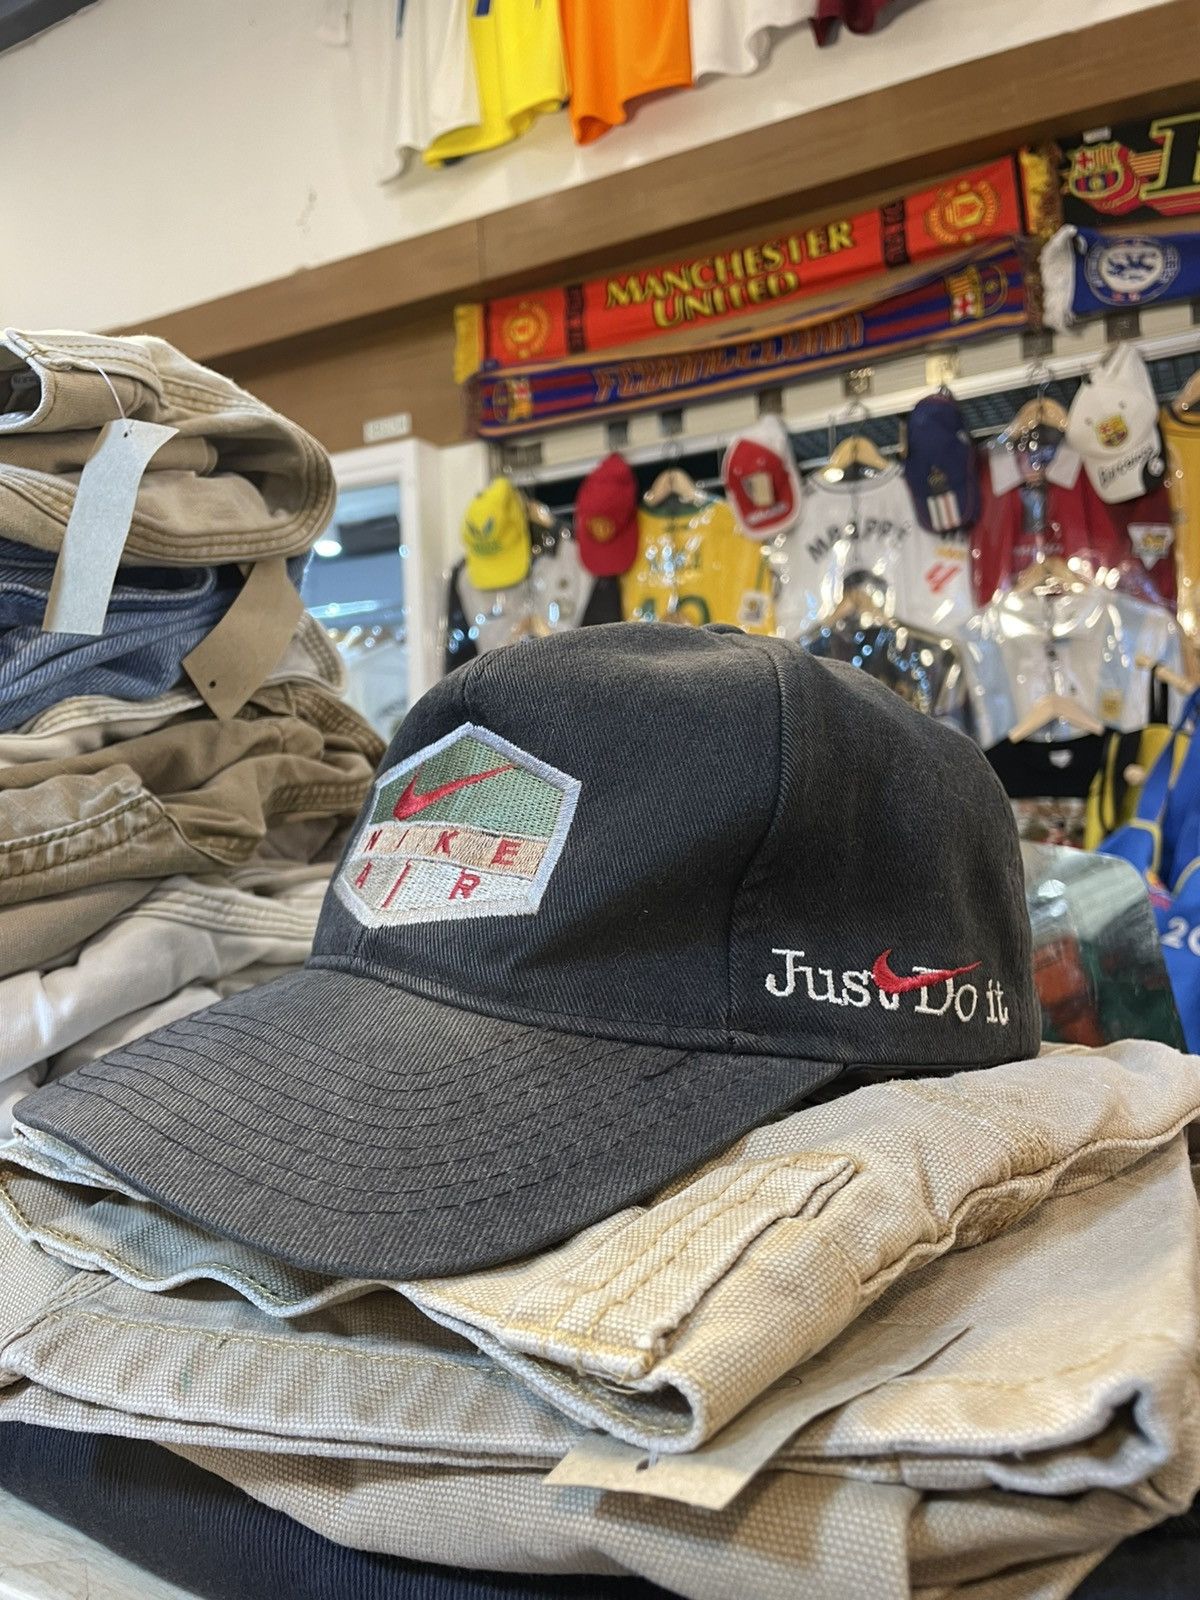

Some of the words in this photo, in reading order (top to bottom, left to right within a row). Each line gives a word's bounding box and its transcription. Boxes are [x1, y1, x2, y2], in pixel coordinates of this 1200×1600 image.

[606, 221, 854, 308] MANCHESTER
[652, 271, 798, 328] UNITED
[364, 829, 521, 868] NIKE
[355, 859, 481, 910] AIR
[912, 965, 978, 1022] Do
